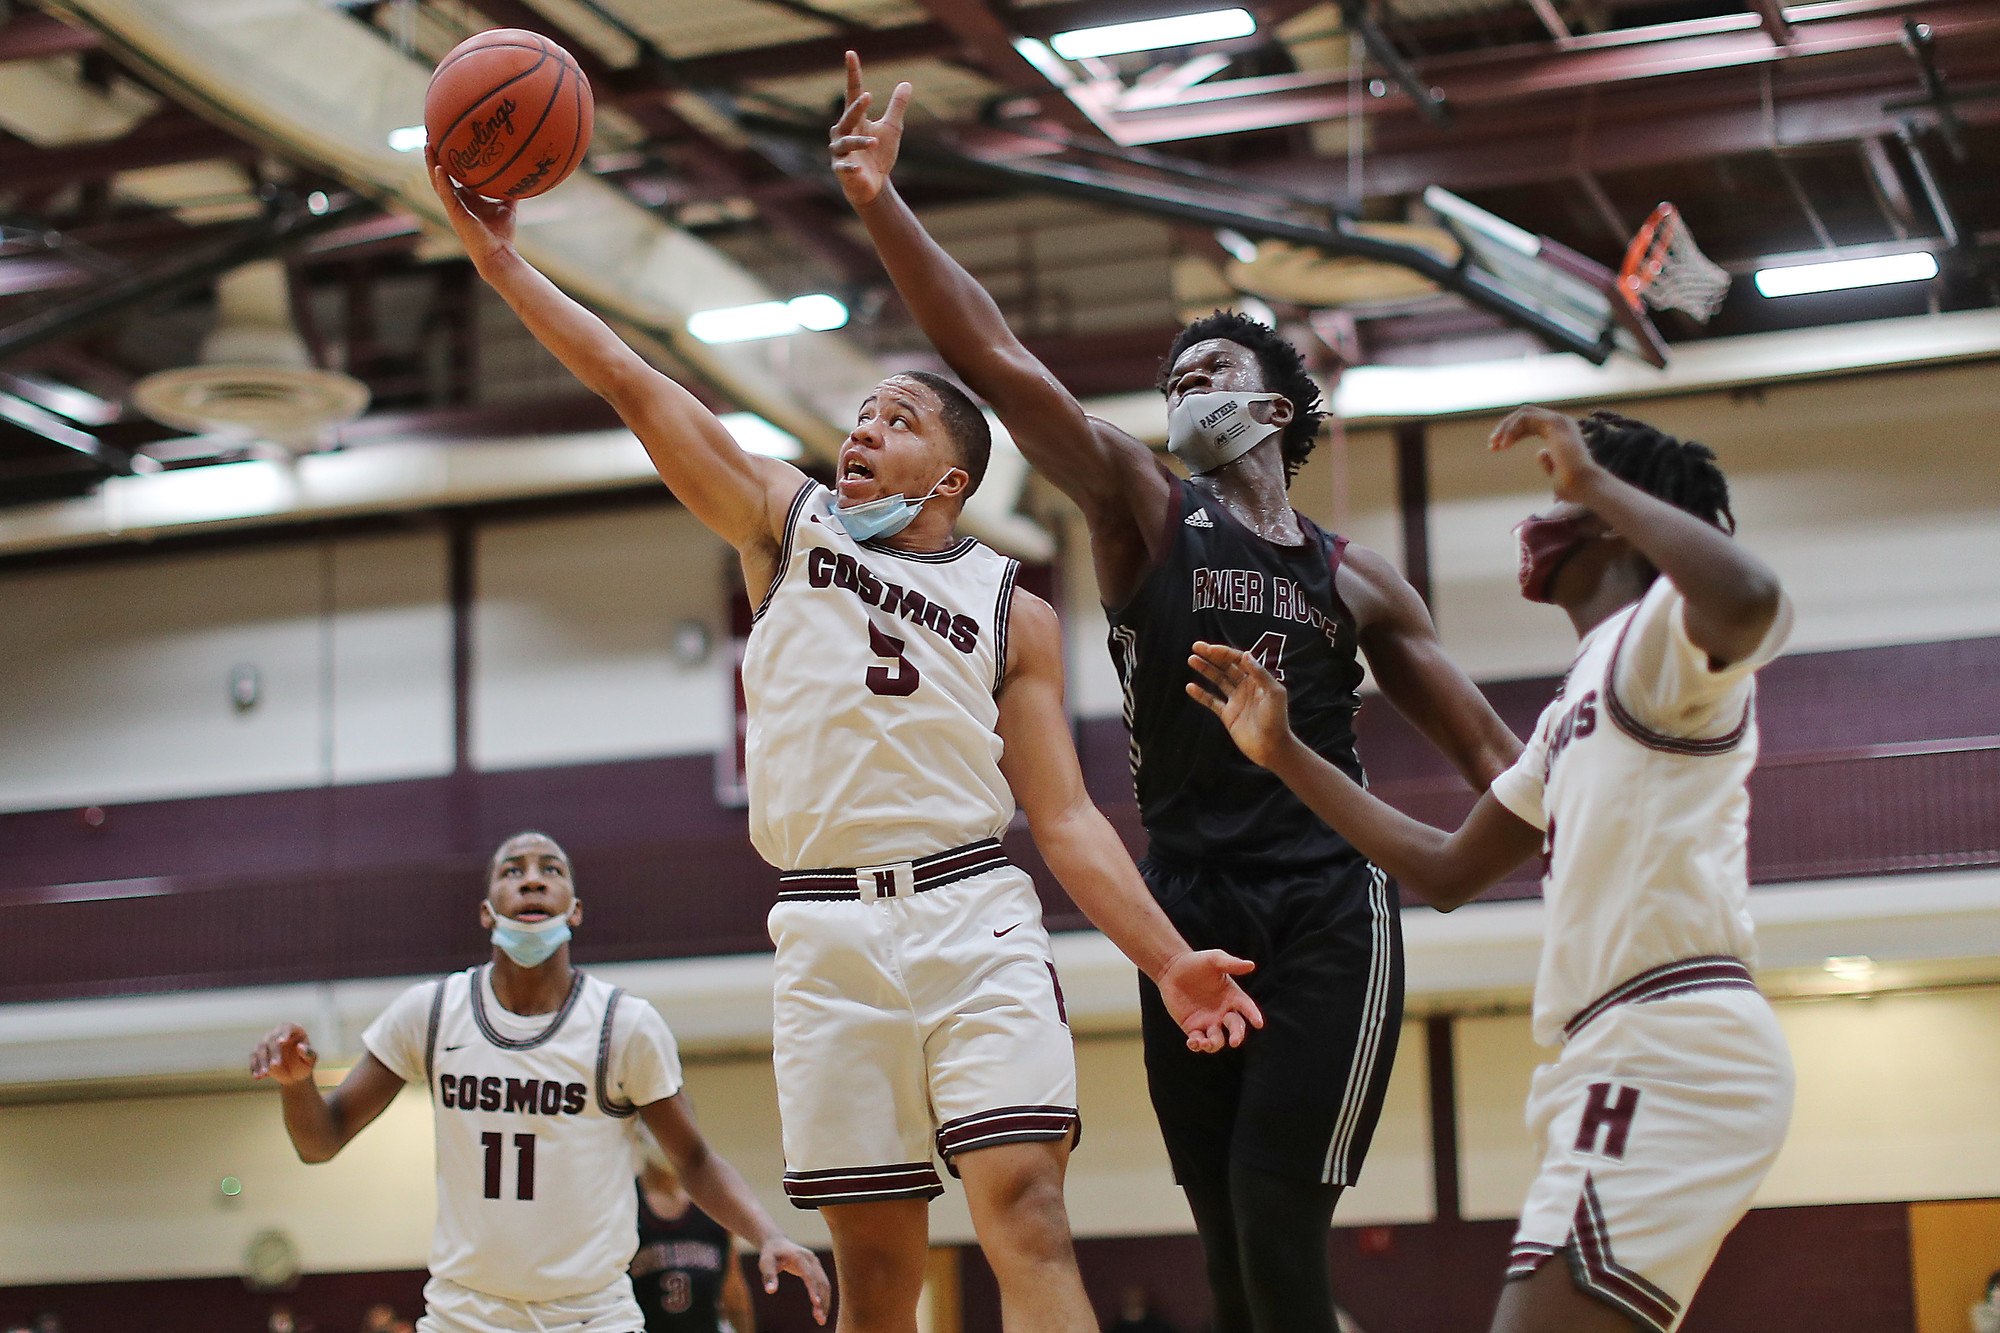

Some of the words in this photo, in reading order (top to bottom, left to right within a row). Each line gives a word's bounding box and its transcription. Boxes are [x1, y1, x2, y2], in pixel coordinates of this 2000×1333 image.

[449, 98, 517, 178] Rawlings
[1199, 400, 1239, 428] PANTHERS
[1184, 518, 1214, 528] adidas
[808, 546, 980, 655] COSMOS
[865, 617, 920, 697] 5
[872, 869, 897, 898] H
[440, 1073, 588, 1116] COSMOS
[1573, 1082, 1641, 1163] H
[481, 1131, 536, 1200] 11
[660, 1272, 693, 1314] 3
